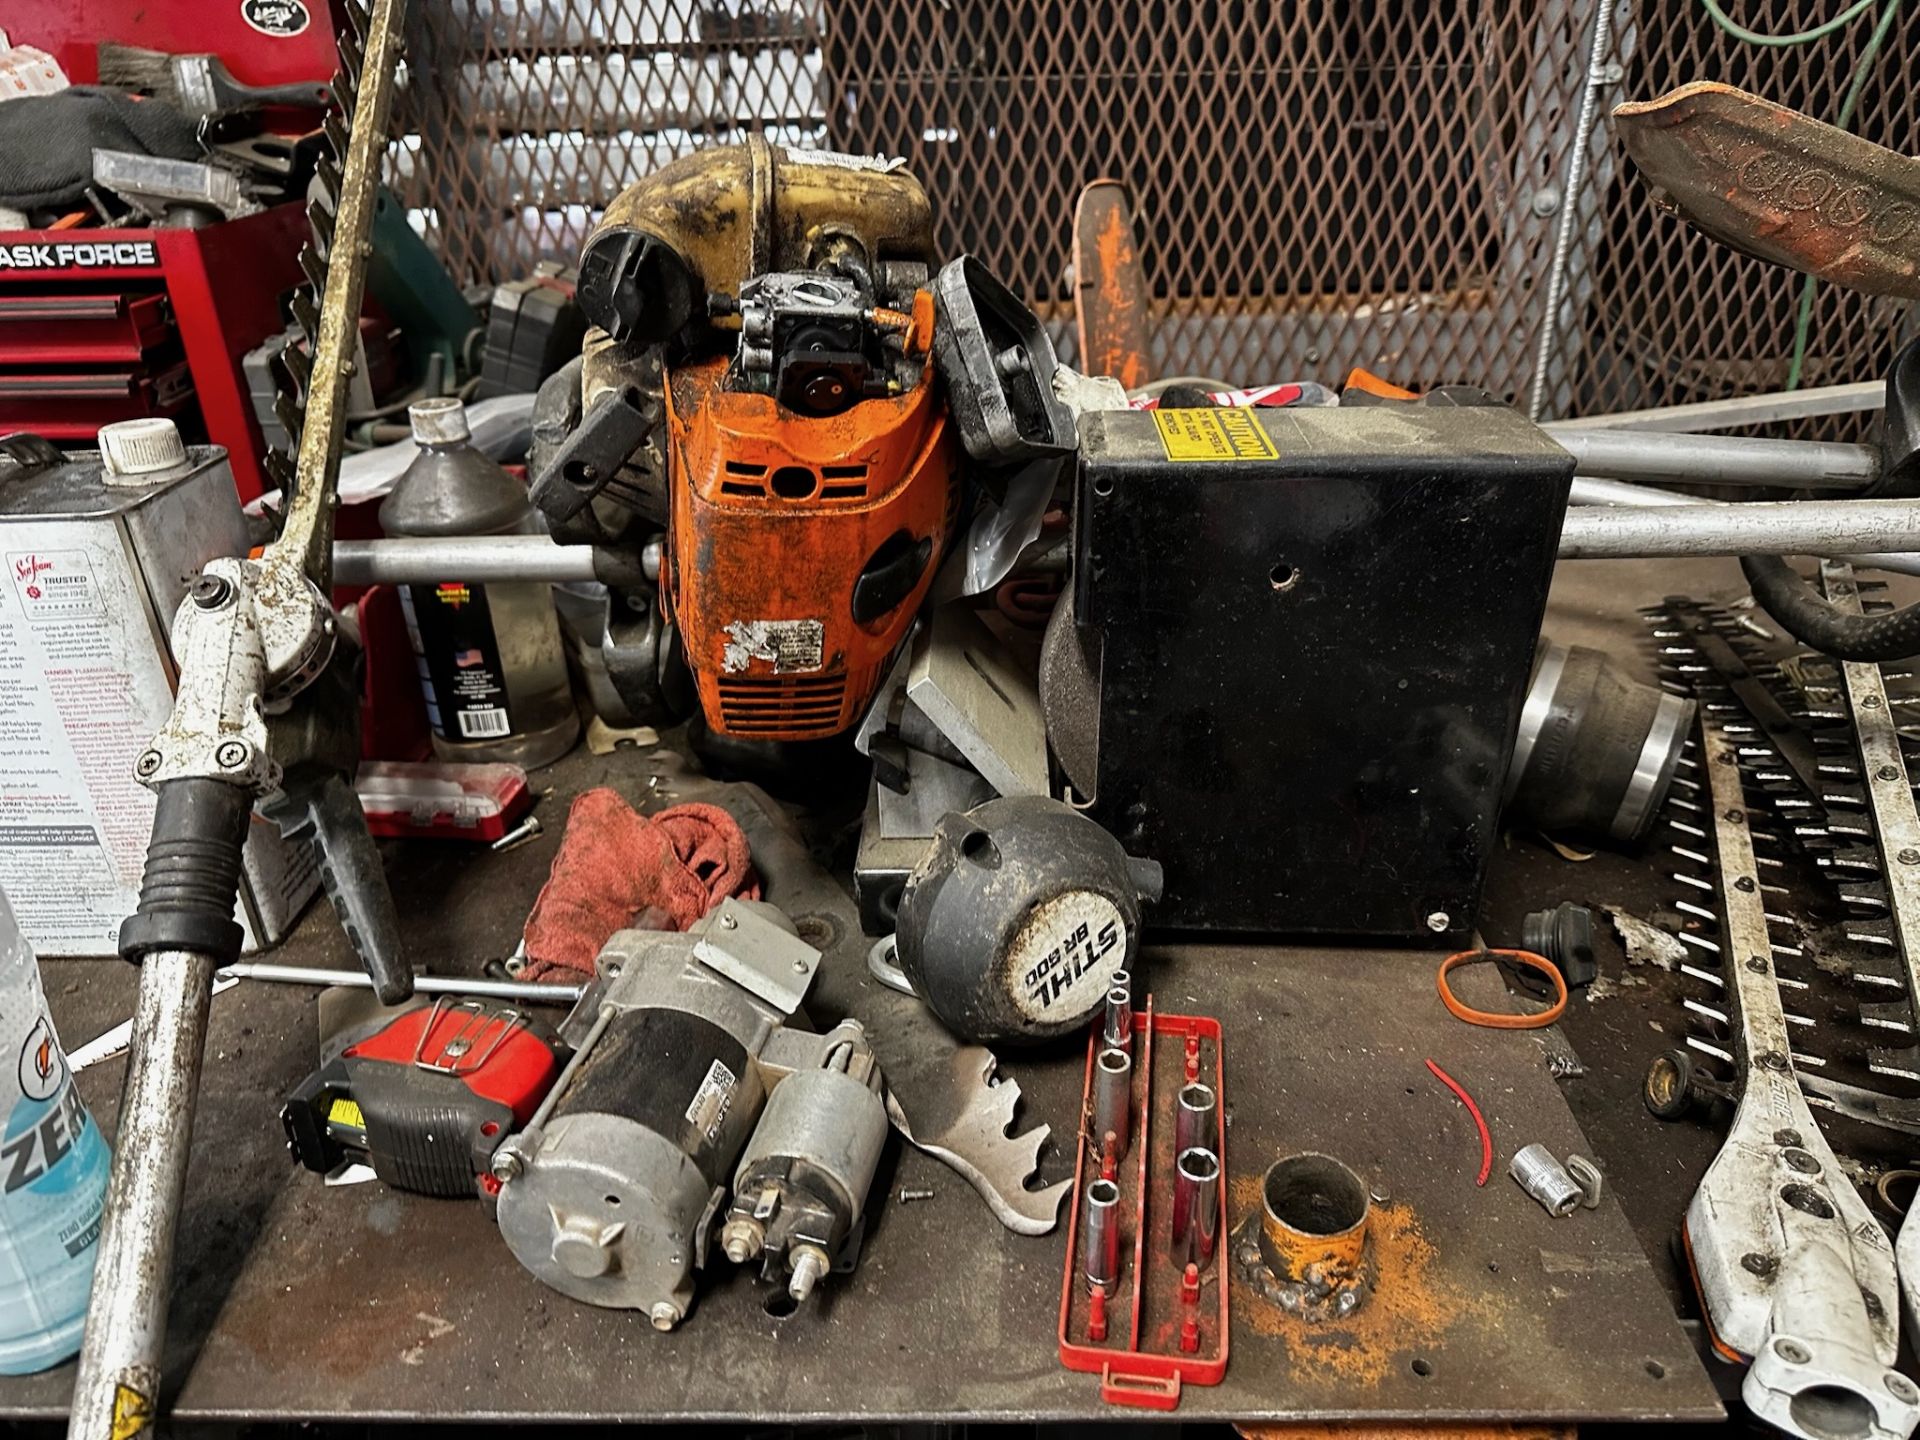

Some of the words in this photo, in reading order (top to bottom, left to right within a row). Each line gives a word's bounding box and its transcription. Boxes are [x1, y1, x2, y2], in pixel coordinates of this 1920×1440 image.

[56, 243, 155, 266] FORCE
[1163, 412, 1180, 434] REMOVED
[1180, 412, 1192, 424] WITH
[1186, 425, 1202, 441] GUARD
[1200, 420, 1214, 430] NOT
[1219, 410, 1267, 455] CAUTION
[1206, 431, 1227, 454] OPERATE
[43, 575, 87, 584] TRUSTED
[70, 590, 88, 598] 1942
[31, 624, 60, 632] Complies
[68, 834, 95, 842] LONGER
[1063, 922, 1089, 954] BR
[1029, 920, 1117, 1008] STIHL
[58, 1219, 80, 1244] ZERO
[78, 1201, 102, 1228] SUGAR
